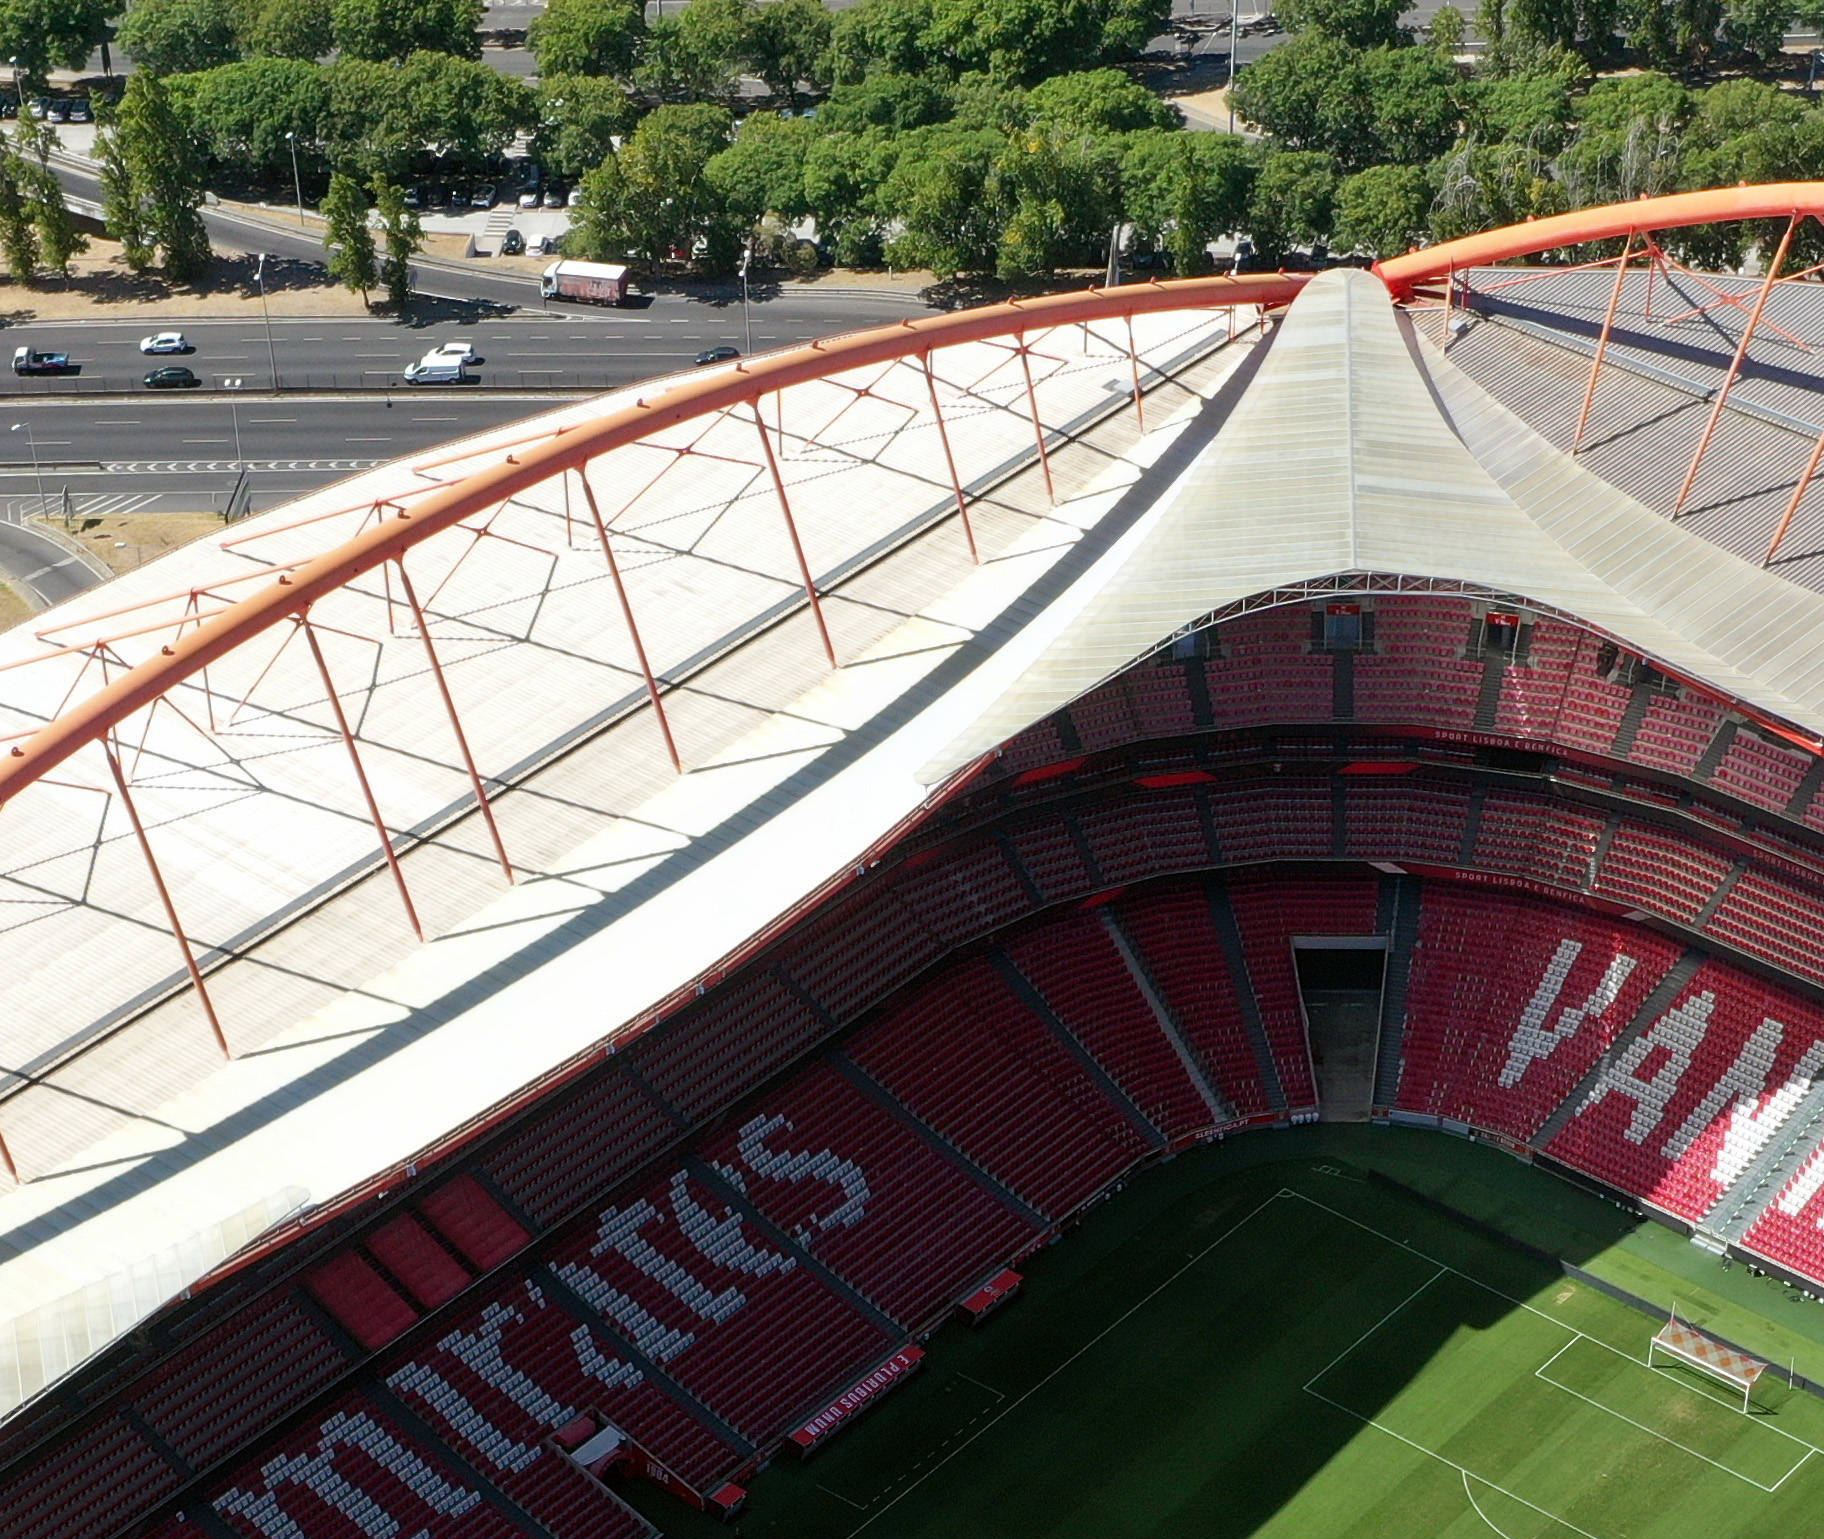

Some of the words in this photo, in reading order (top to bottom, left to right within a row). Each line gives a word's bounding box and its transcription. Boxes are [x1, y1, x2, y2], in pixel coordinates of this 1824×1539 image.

[1435, 730, 1468, 742] SPORT
[1473, 735, 1511, 748] LISBOA
[1524, 741, 1568, 757] BENFICA
[1455, 871, 1488, 884] SPORT
[1492, 876, 1530, 890] LISBOA
[1543, 887, 1585, 904] BENFICA
[896, 1354, 910, 1366] E
[839, 1362, 900, 1408] PLURIBUS
[804, 1406, 844, 1436] UNUM
